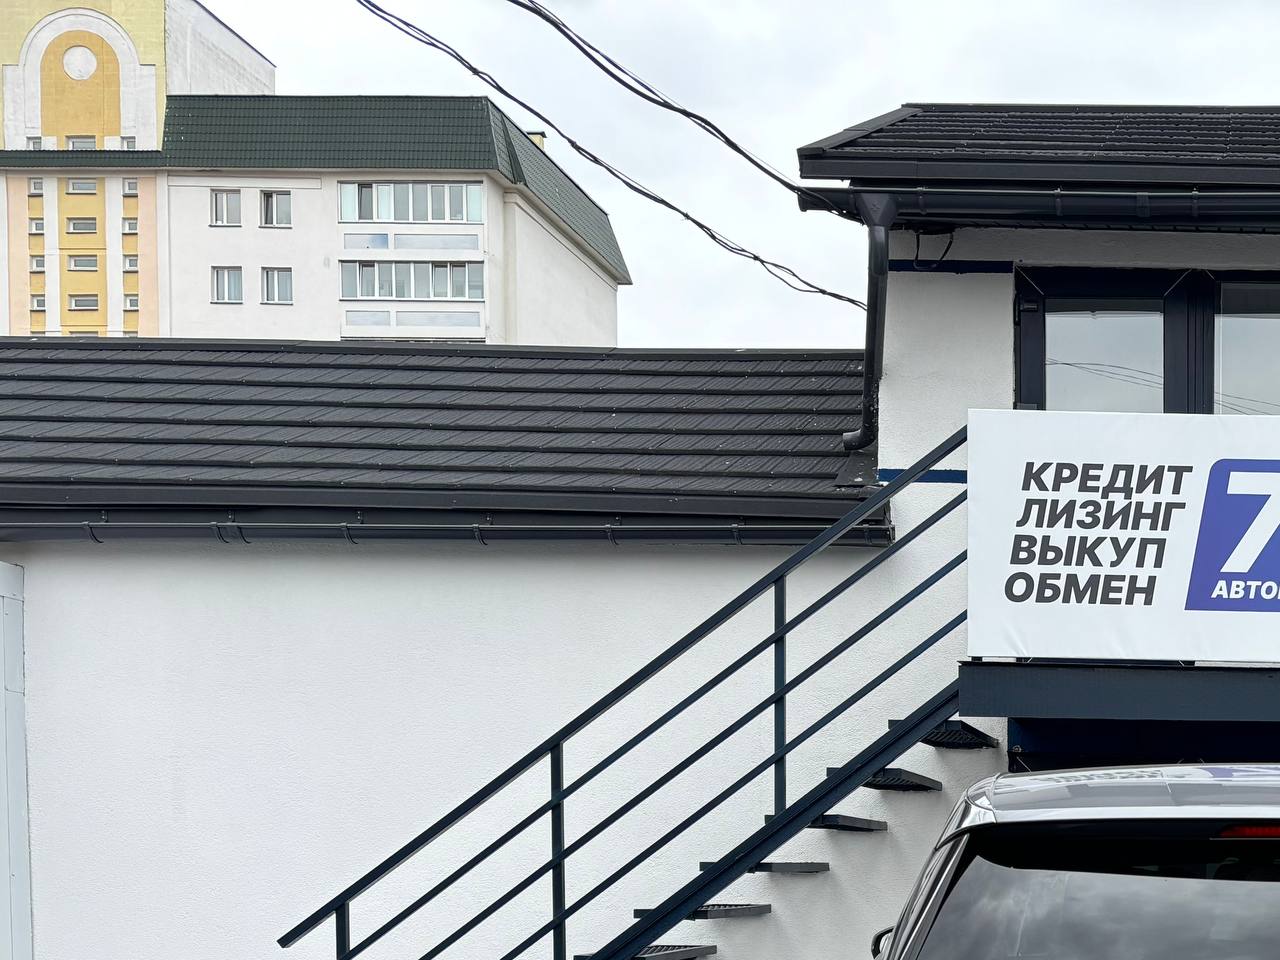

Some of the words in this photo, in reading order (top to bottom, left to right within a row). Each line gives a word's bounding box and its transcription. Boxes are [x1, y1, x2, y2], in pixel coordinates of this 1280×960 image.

[1021, 461, 1194, 500] КРЕДИТ
[1015, 498, 1187, 532] ЛИЗИНГ
[1009, 534, 1167, 569] ВЫКУП
[1004, 571, 1157, 606] ОБМЕН
